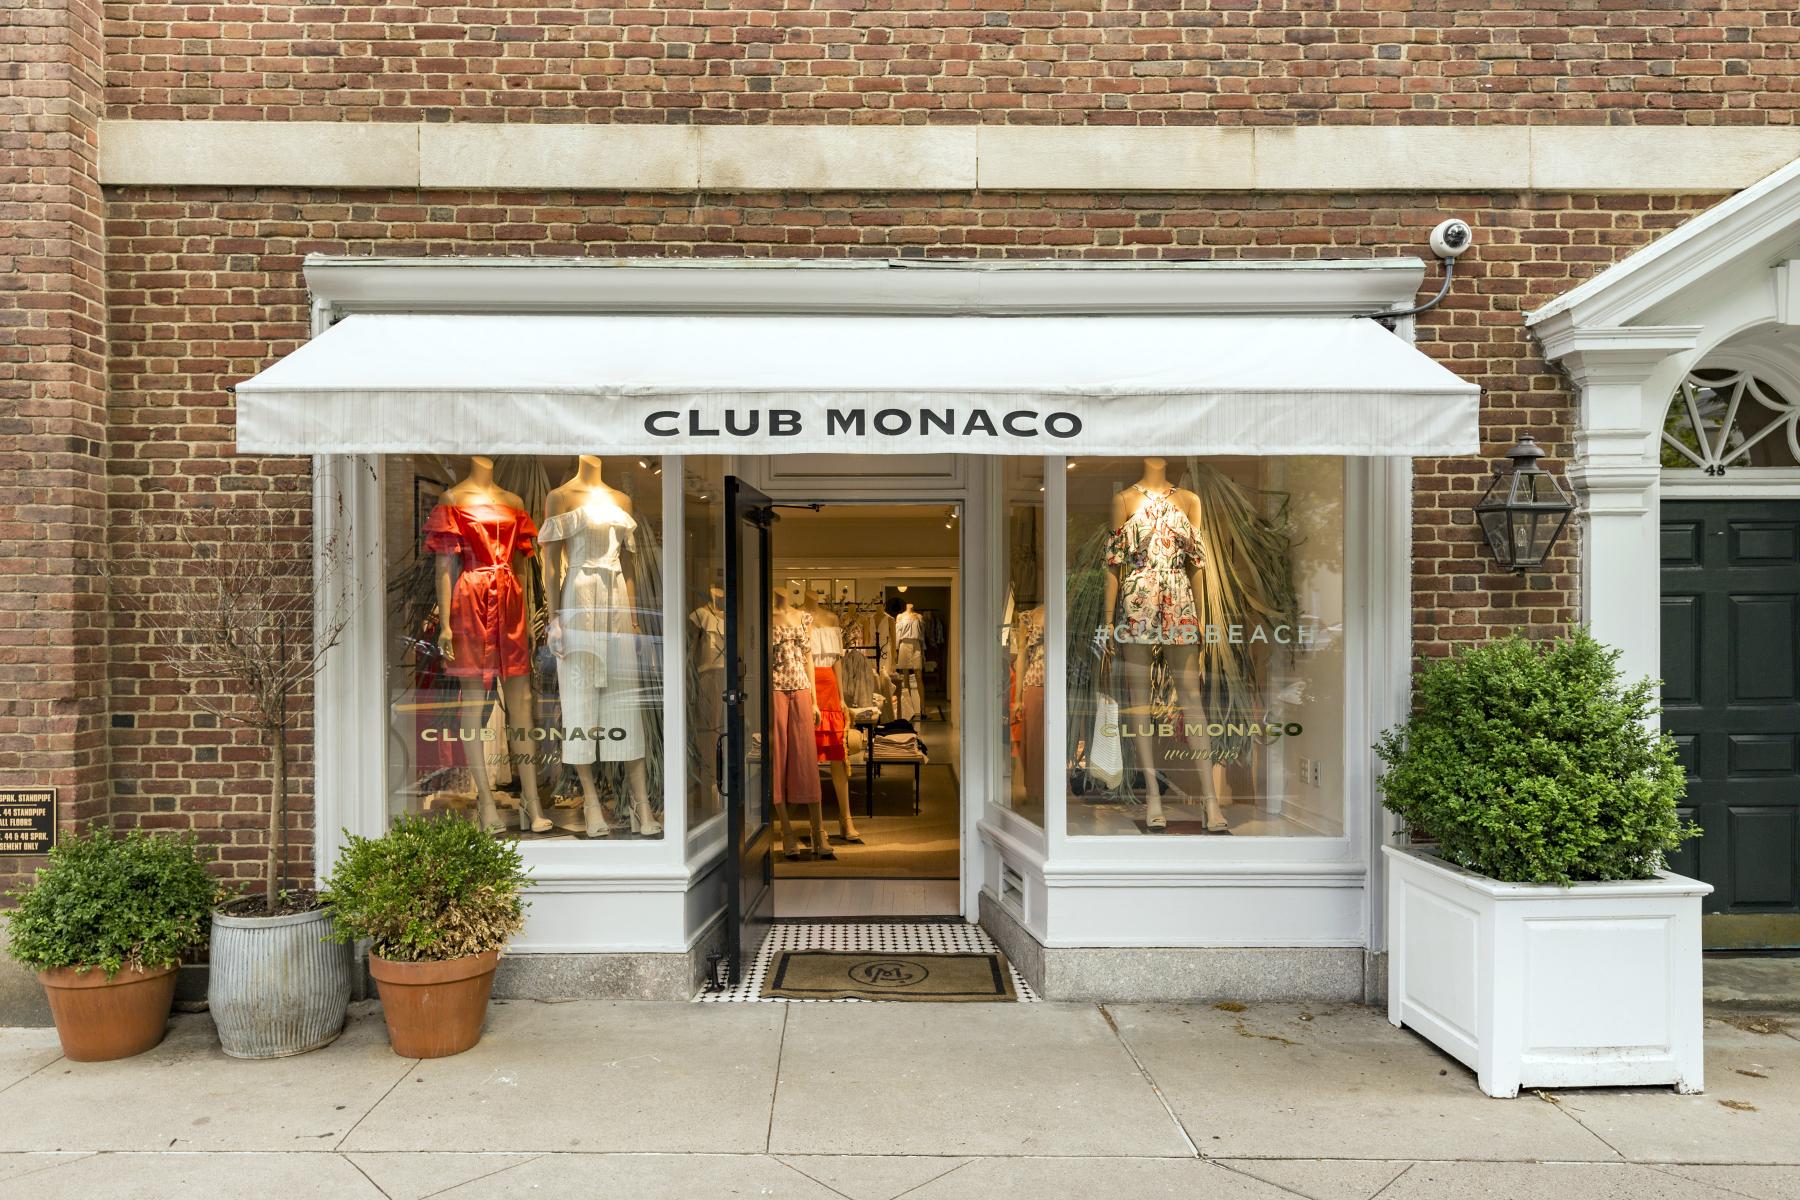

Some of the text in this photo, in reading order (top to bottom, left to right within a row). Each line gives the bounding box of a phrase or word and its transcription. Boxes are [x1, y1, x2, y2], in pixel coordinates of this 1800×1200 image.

[643, 408, 1083, 439] CLUB MONACO
[1704, 464, 1726, 477] 48
[1094, 624, 1314, 644] #CLUBBEACH
[420, 726, 627, 742] CLUB MONACO
[1099, 722, 1303, 738] CLUB MONACO
[18, 794, 52, 802] STANDPIPE
[3, 808, 46, 817] 44 STANDPIPE
[10, 818, 33, 827] FLOORS
[4, 832, 13, 841] 44
[20, 832, 29, 841] 48
[30, 832, 49, 841] SPRK.
[24, 842, 39, 851] ONLY
